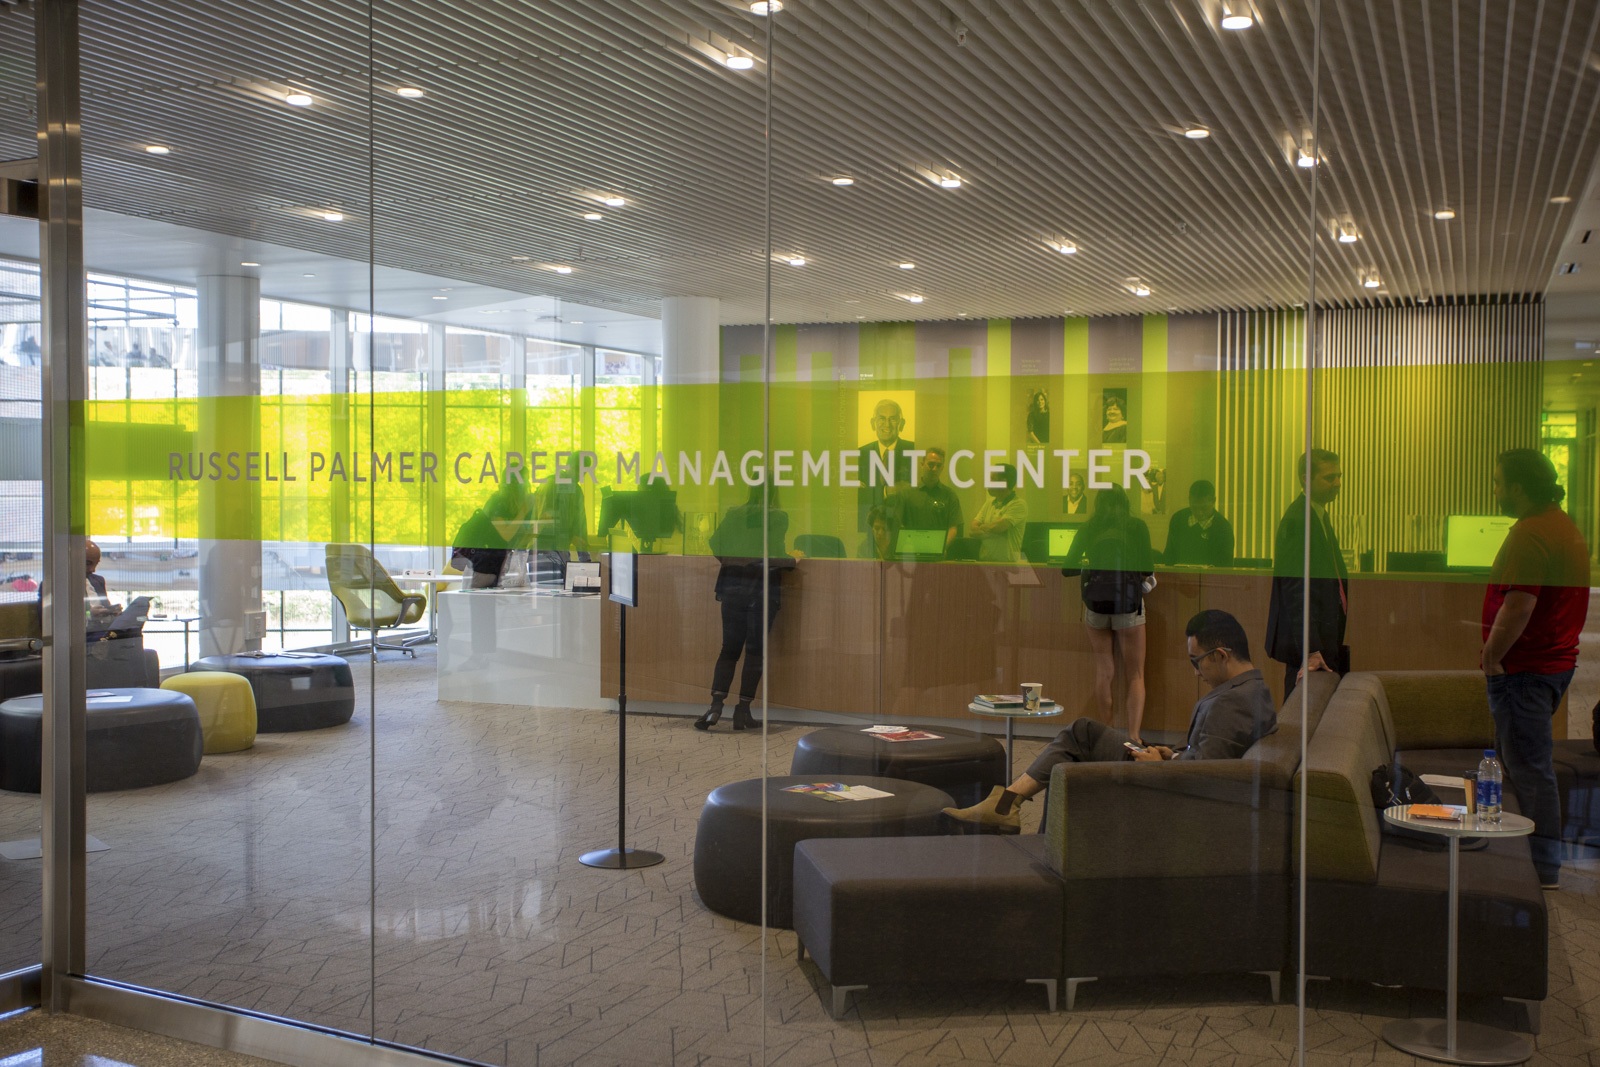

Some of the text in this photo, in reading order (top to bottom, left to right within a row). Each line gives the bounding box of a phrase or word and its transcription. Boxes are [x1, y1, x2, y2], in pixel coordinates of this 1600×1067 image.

[168, 451, 297, 481] RUSSELL
[309, 451, 439, 483] PALMER
[454, 450, 599, 485] CAREER
[616, 449, 927, 488] MANAGEMENT
[948, 449, 1152, 490] CENTER
